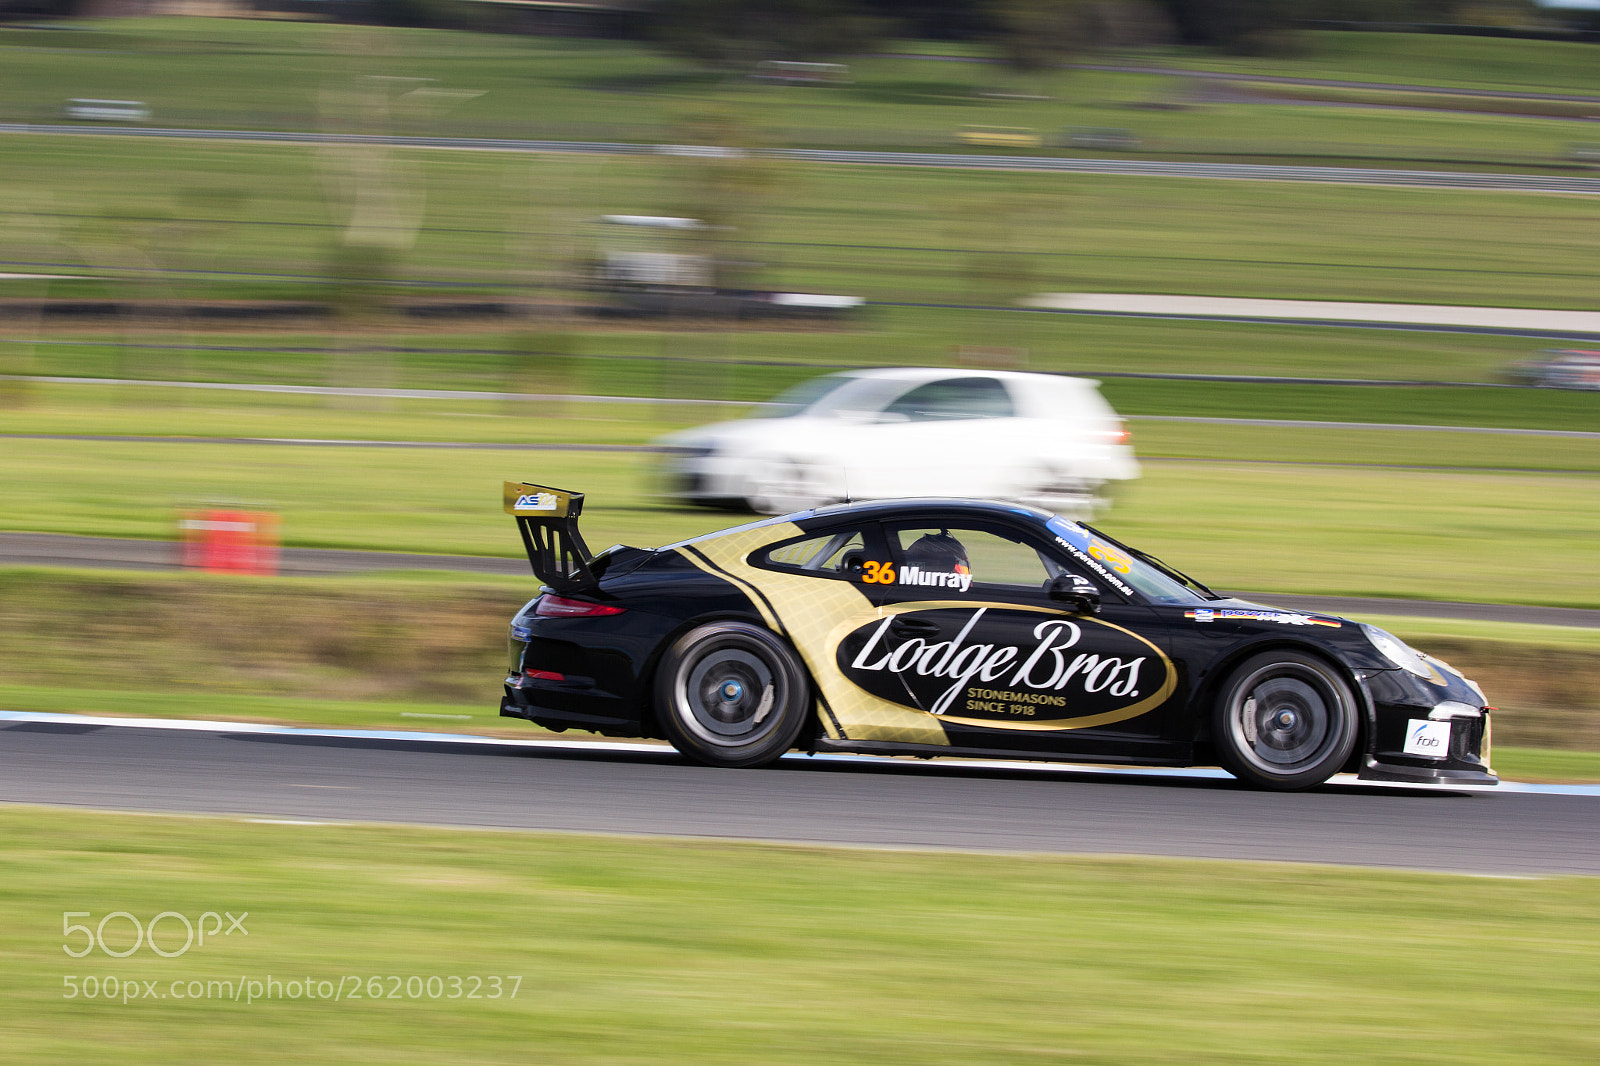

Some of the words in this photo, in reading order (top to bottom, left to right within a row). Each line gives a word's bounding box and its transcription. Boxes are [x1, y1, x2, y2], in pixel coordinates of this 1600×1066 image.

[862, 560, 896, 585] 36
[899, 566, 973, 593] Murray
[1055, 536, 1134, 596] www.porsche.com.au
[851, 607, 1018, 715] Lodge
[1009, 620, 1146, 697] Bros.
[966, 700, 1006, 713] SINCE
[1009, 704, 1036, 716] 1918
[967, 687, 1067, 707] STONEMASONS
